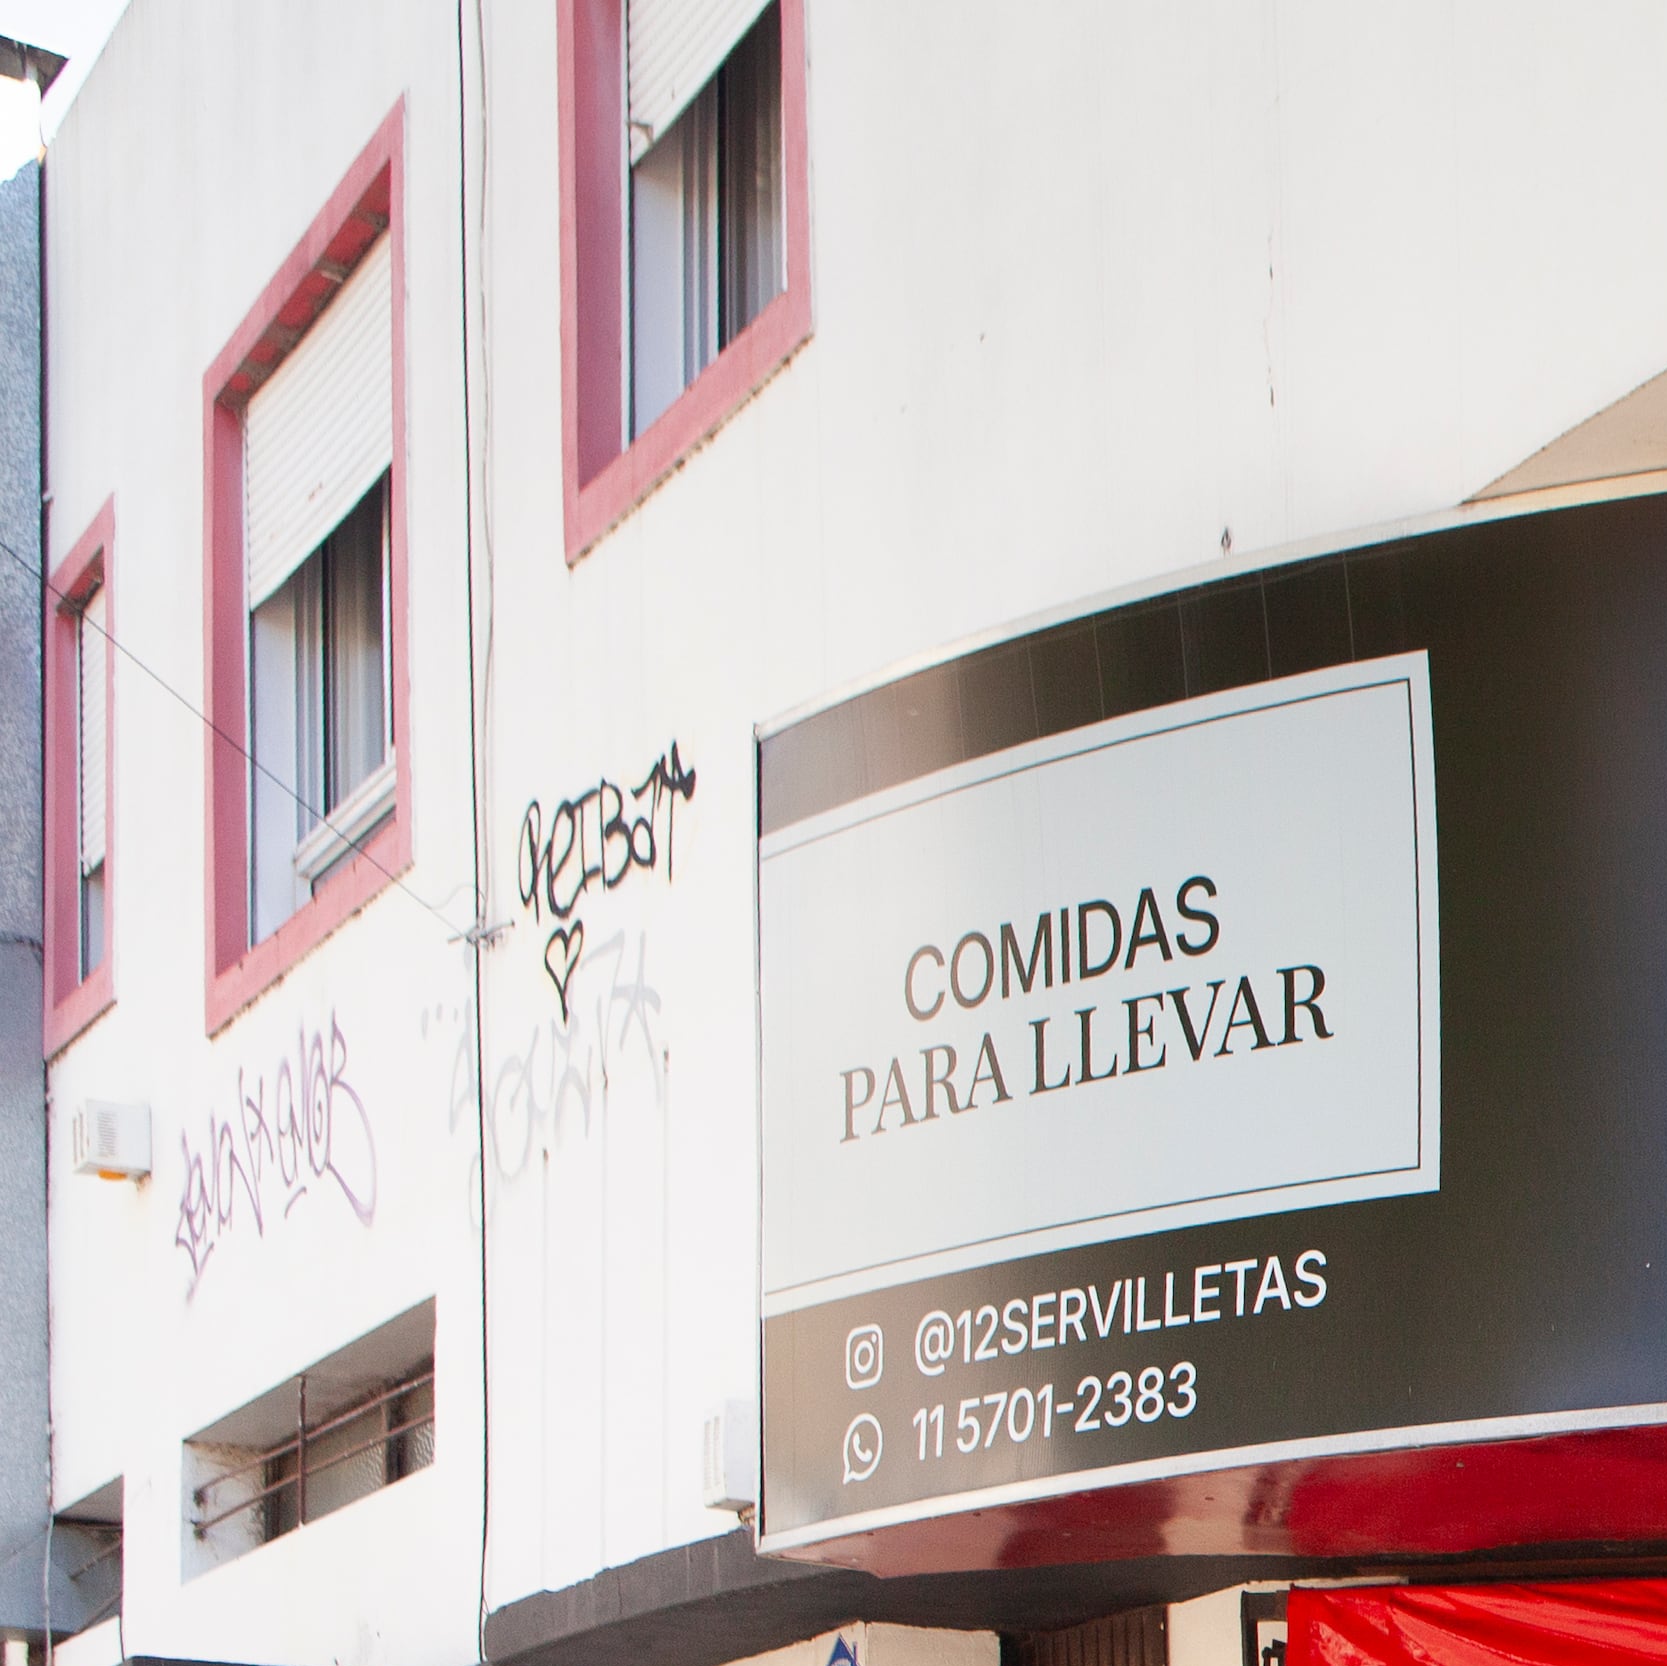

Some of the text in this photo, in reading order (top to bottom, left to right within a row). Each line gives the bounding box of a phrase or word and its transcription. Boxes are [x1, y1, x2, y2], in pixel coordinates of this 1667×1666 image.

[904, 875, 1220, 1022] COMIDAS
[839, 963, 1335, 1144] PARA LLEVAR
[914, 1249, 1328, 1377] @12SERVILLETAS
[912, 1361, 1198, 1461] 11 5701-2383
